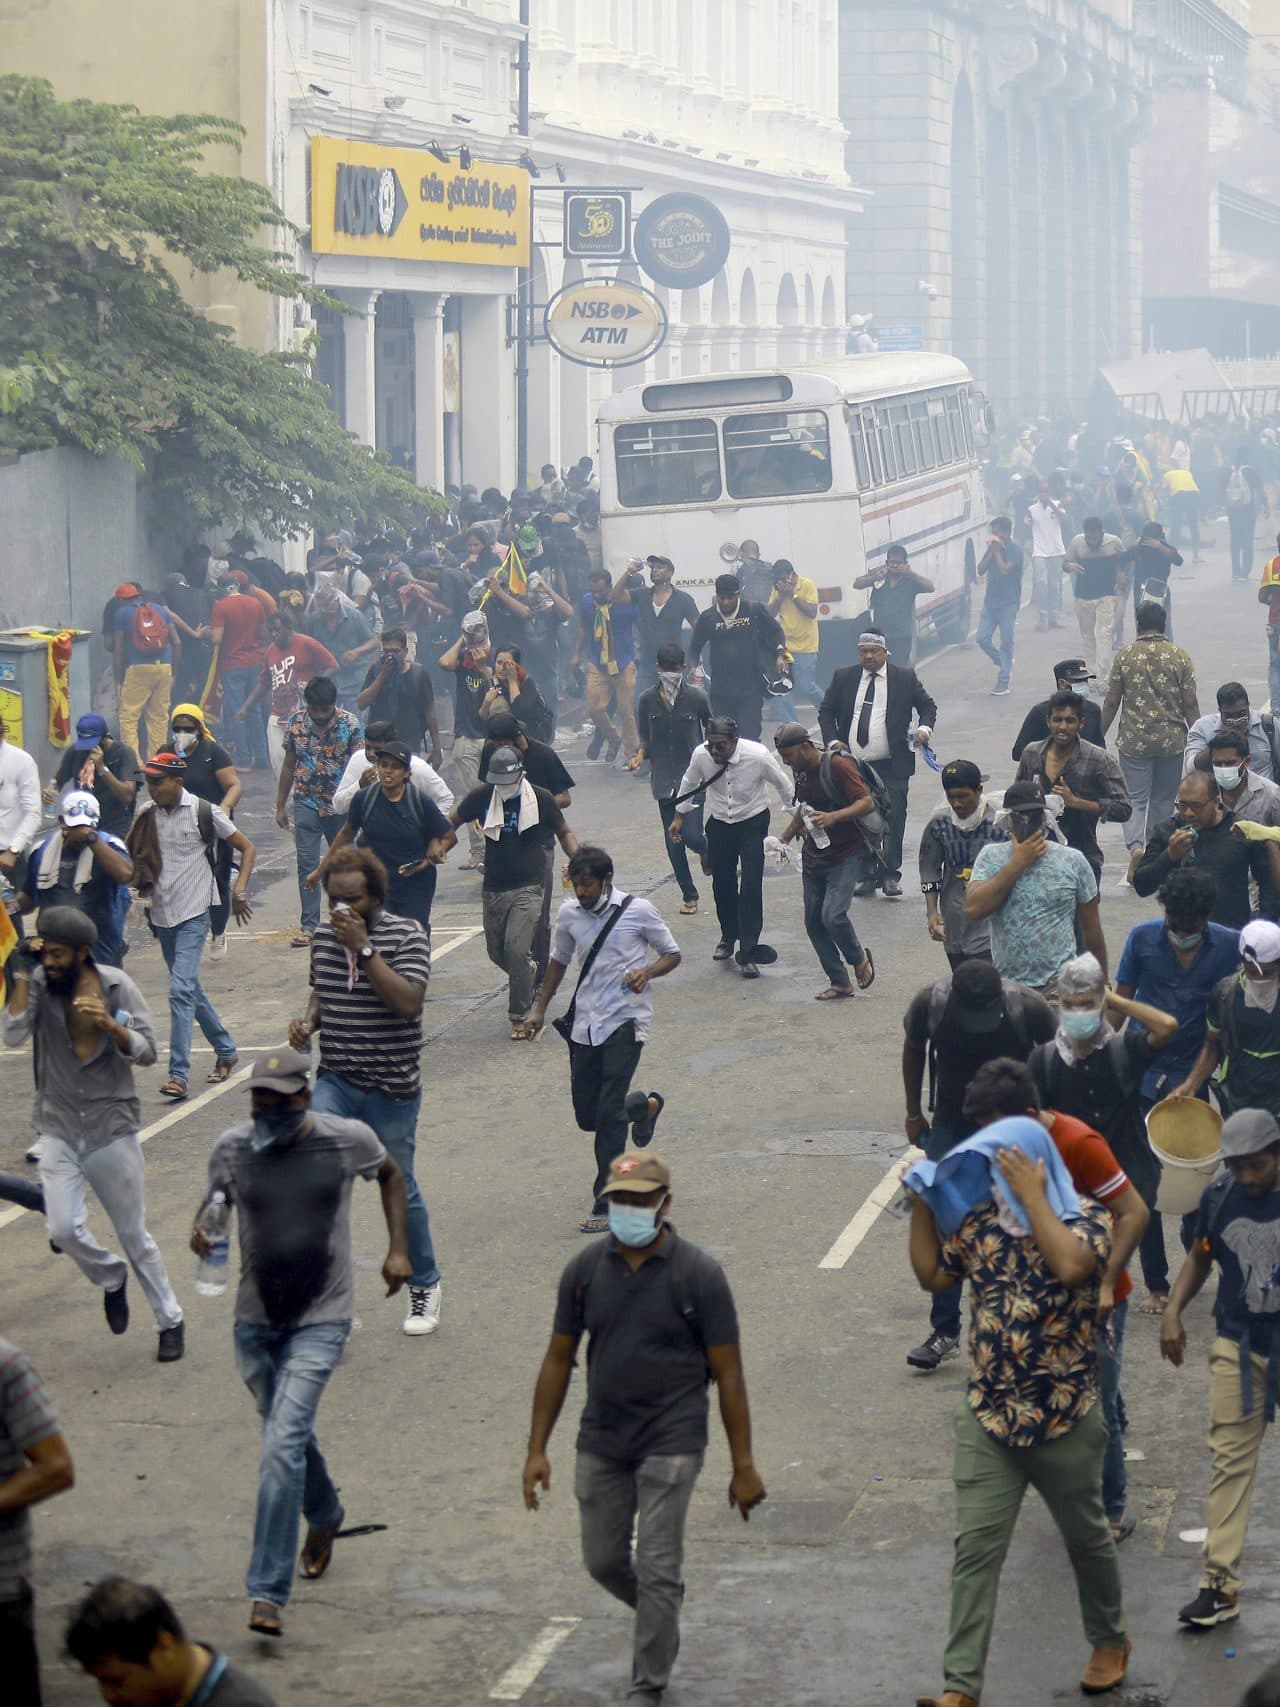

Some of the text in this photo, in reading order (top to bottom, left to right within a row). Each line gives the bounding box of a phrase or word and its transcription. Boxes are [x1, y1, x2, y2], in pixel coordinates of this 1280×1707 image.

[334, 162, 379, 236] NSB
[651, 231, 713, 249] THE JOINT
[570, 301, 610, 319] NSB
[579, 327, 629, 345] ATM
